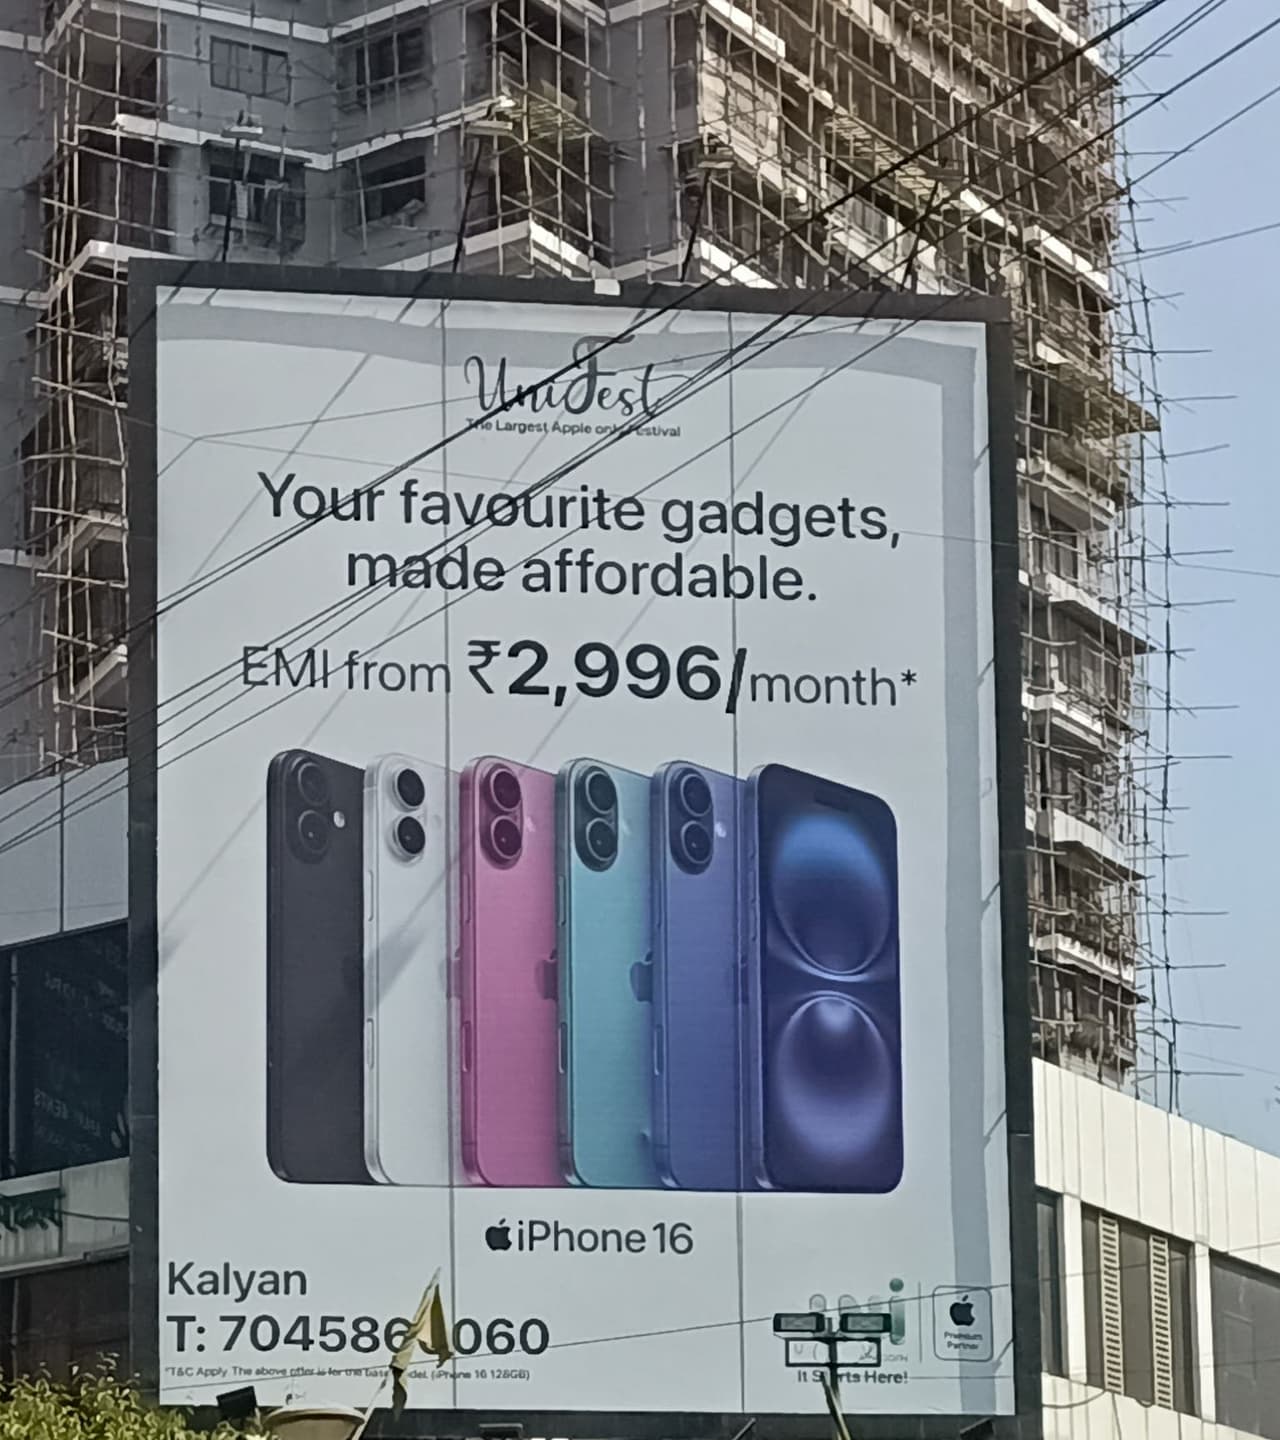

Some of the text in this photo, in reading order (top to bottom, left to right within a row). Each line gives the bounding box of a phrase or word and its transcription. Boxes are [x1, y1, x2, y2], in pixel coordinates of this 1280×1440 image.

[496, 420, 549, 435] Largest
[551, 421, 592, 436] Apple
[628, 425, 681, 438] estival
[258, 471, 901, 550] Your favourite gadgets,
[347, 545, 818, 602] made affordable.
[241, 645, 330, 690] EMI
[345, 648, 452, 694] from
[516, 1220, 694, 1256] iPhone 16
[167, 1261, 307, 1303] Kalyan
[219, 1315, 550, 1356] 704586060
[812, 1370, 861, 1384] Srts
[864, 1370, 908, 1385] Here!
